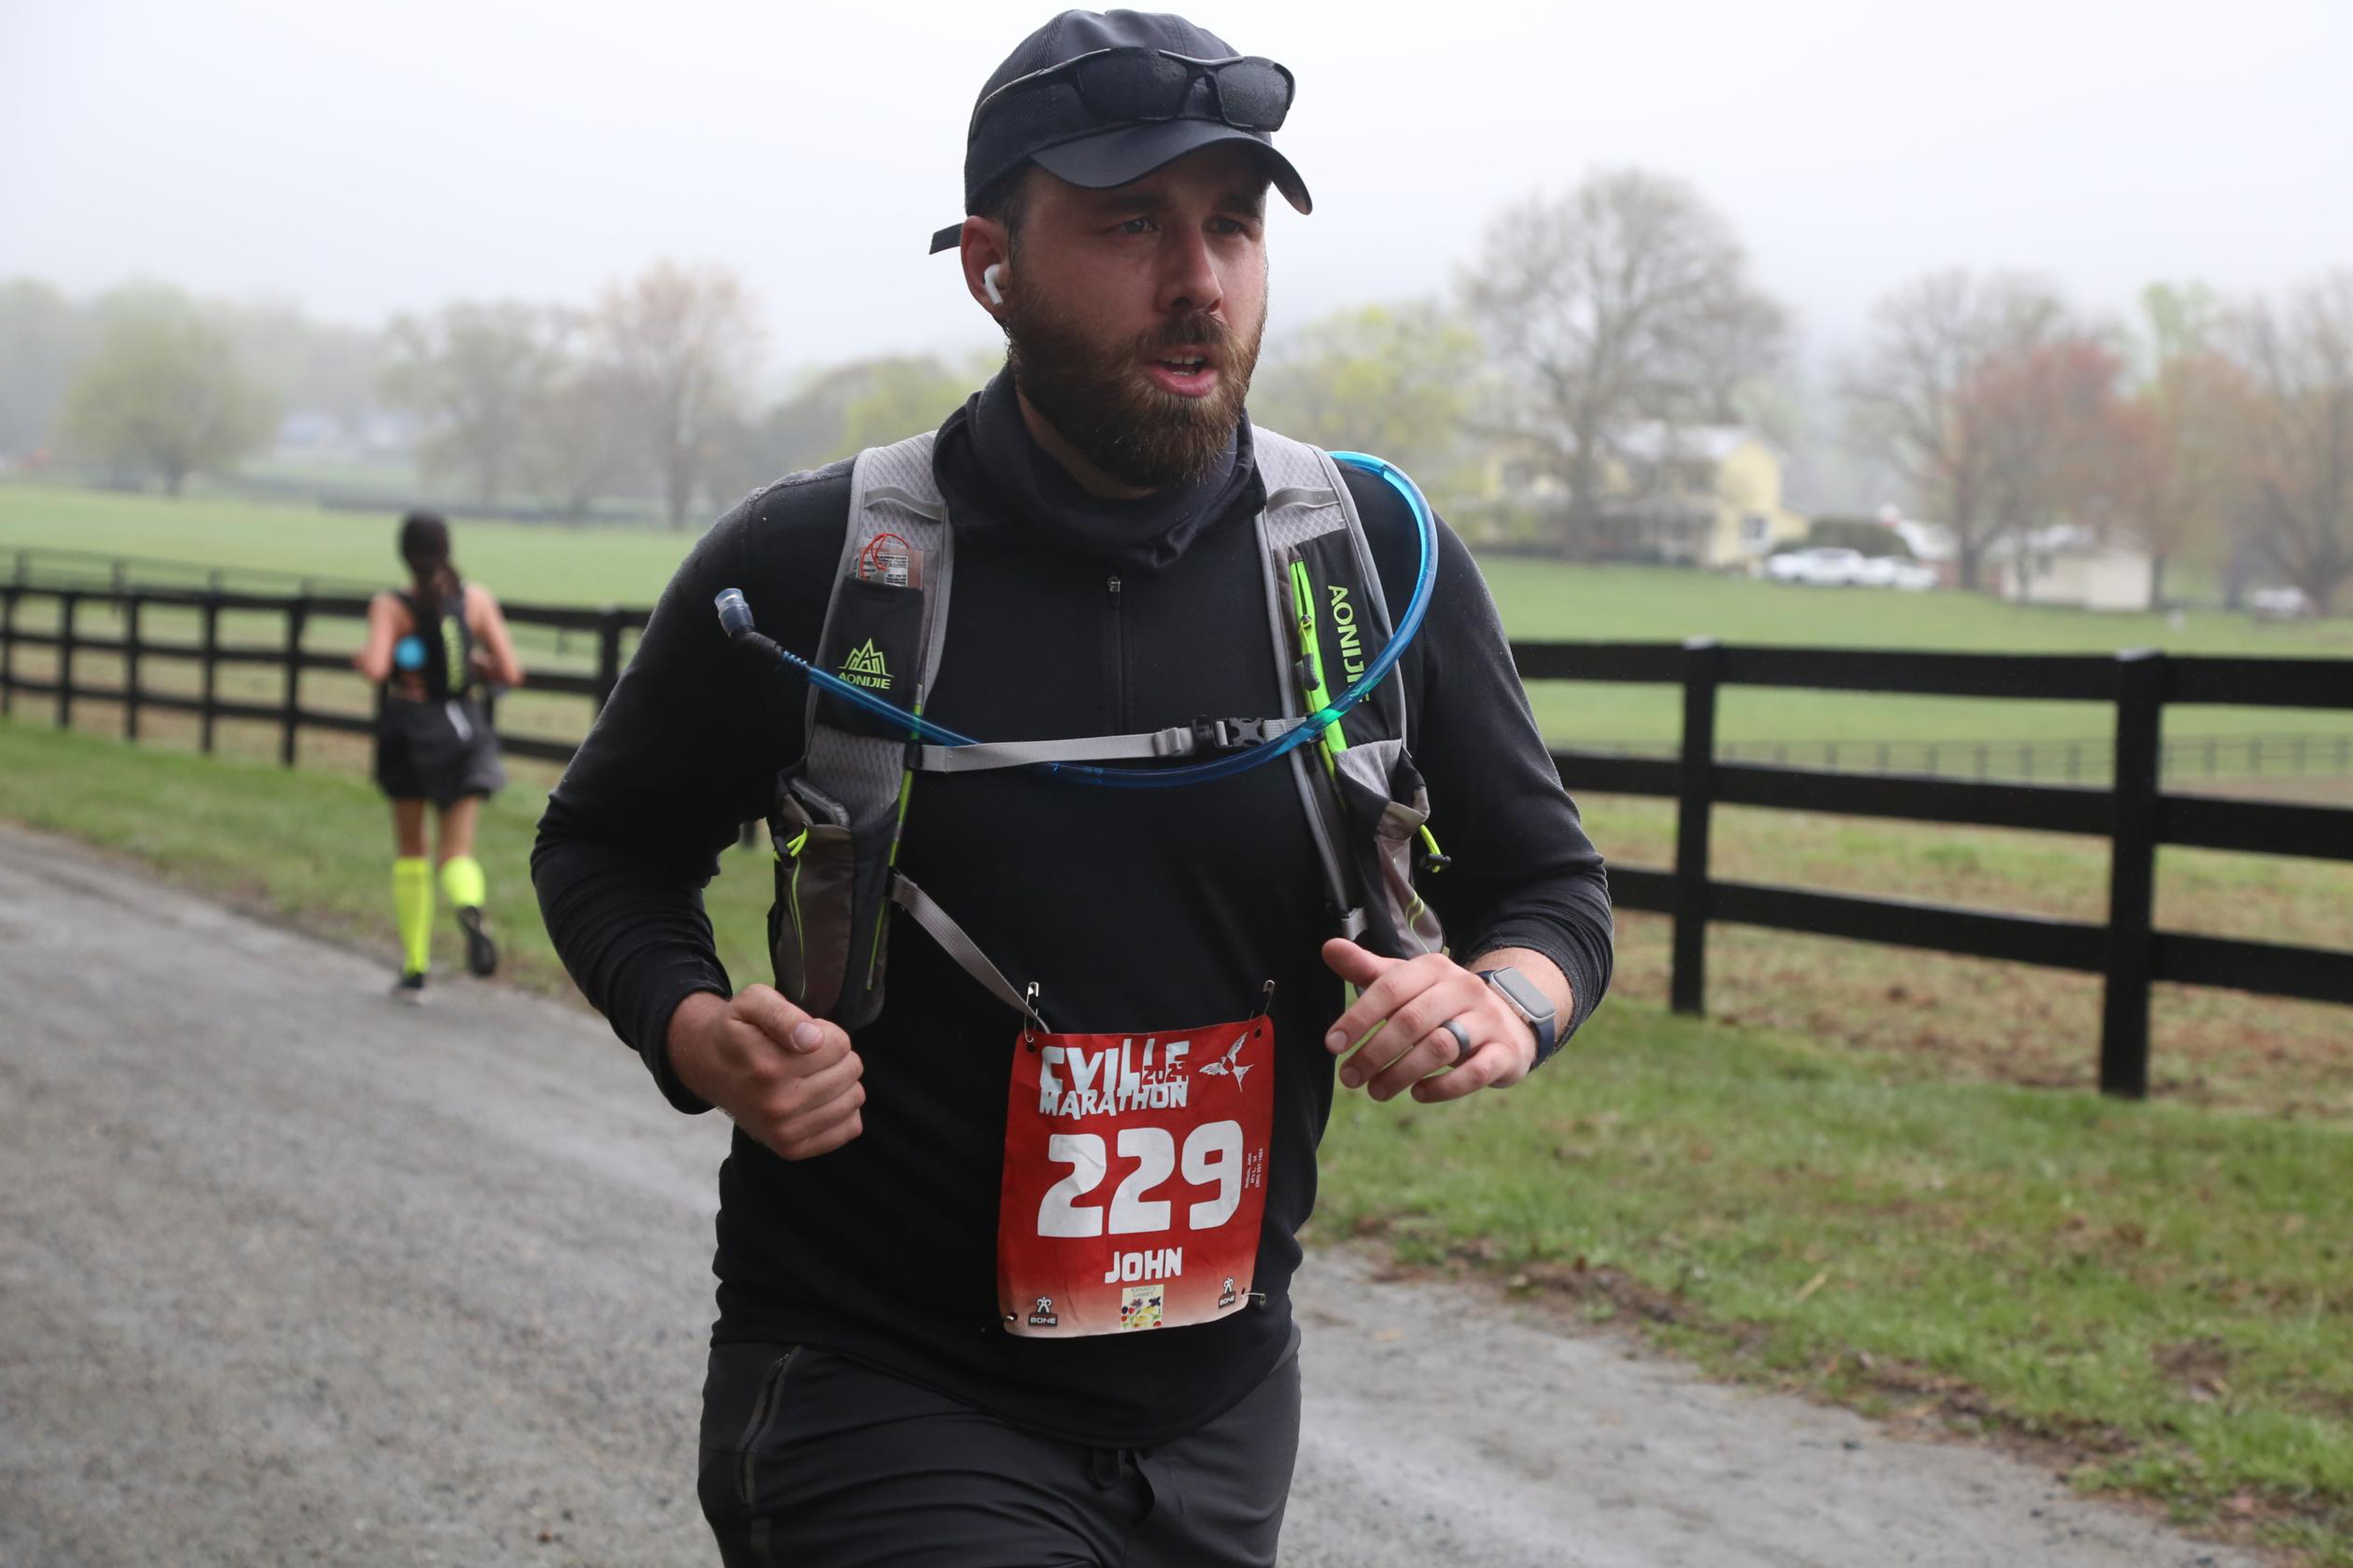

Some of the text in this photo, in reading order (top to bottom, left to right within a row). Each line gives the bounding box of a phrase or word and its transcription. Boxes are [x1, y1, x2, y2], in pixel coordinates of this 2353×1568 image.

[1328, 585, 1369, 702] AONIJI
[838, 672, 890, 689] AONIJIE
[1040, 1038, 1190, 1096] EVILLE
[1039, 1084, 1188, 1120] MARATHON
[1038, 1120, 1243, 1236] 229
[1104, 1247, 1182, 1284] JOHN
[1219, 1296, 1235, 1306] BONE
